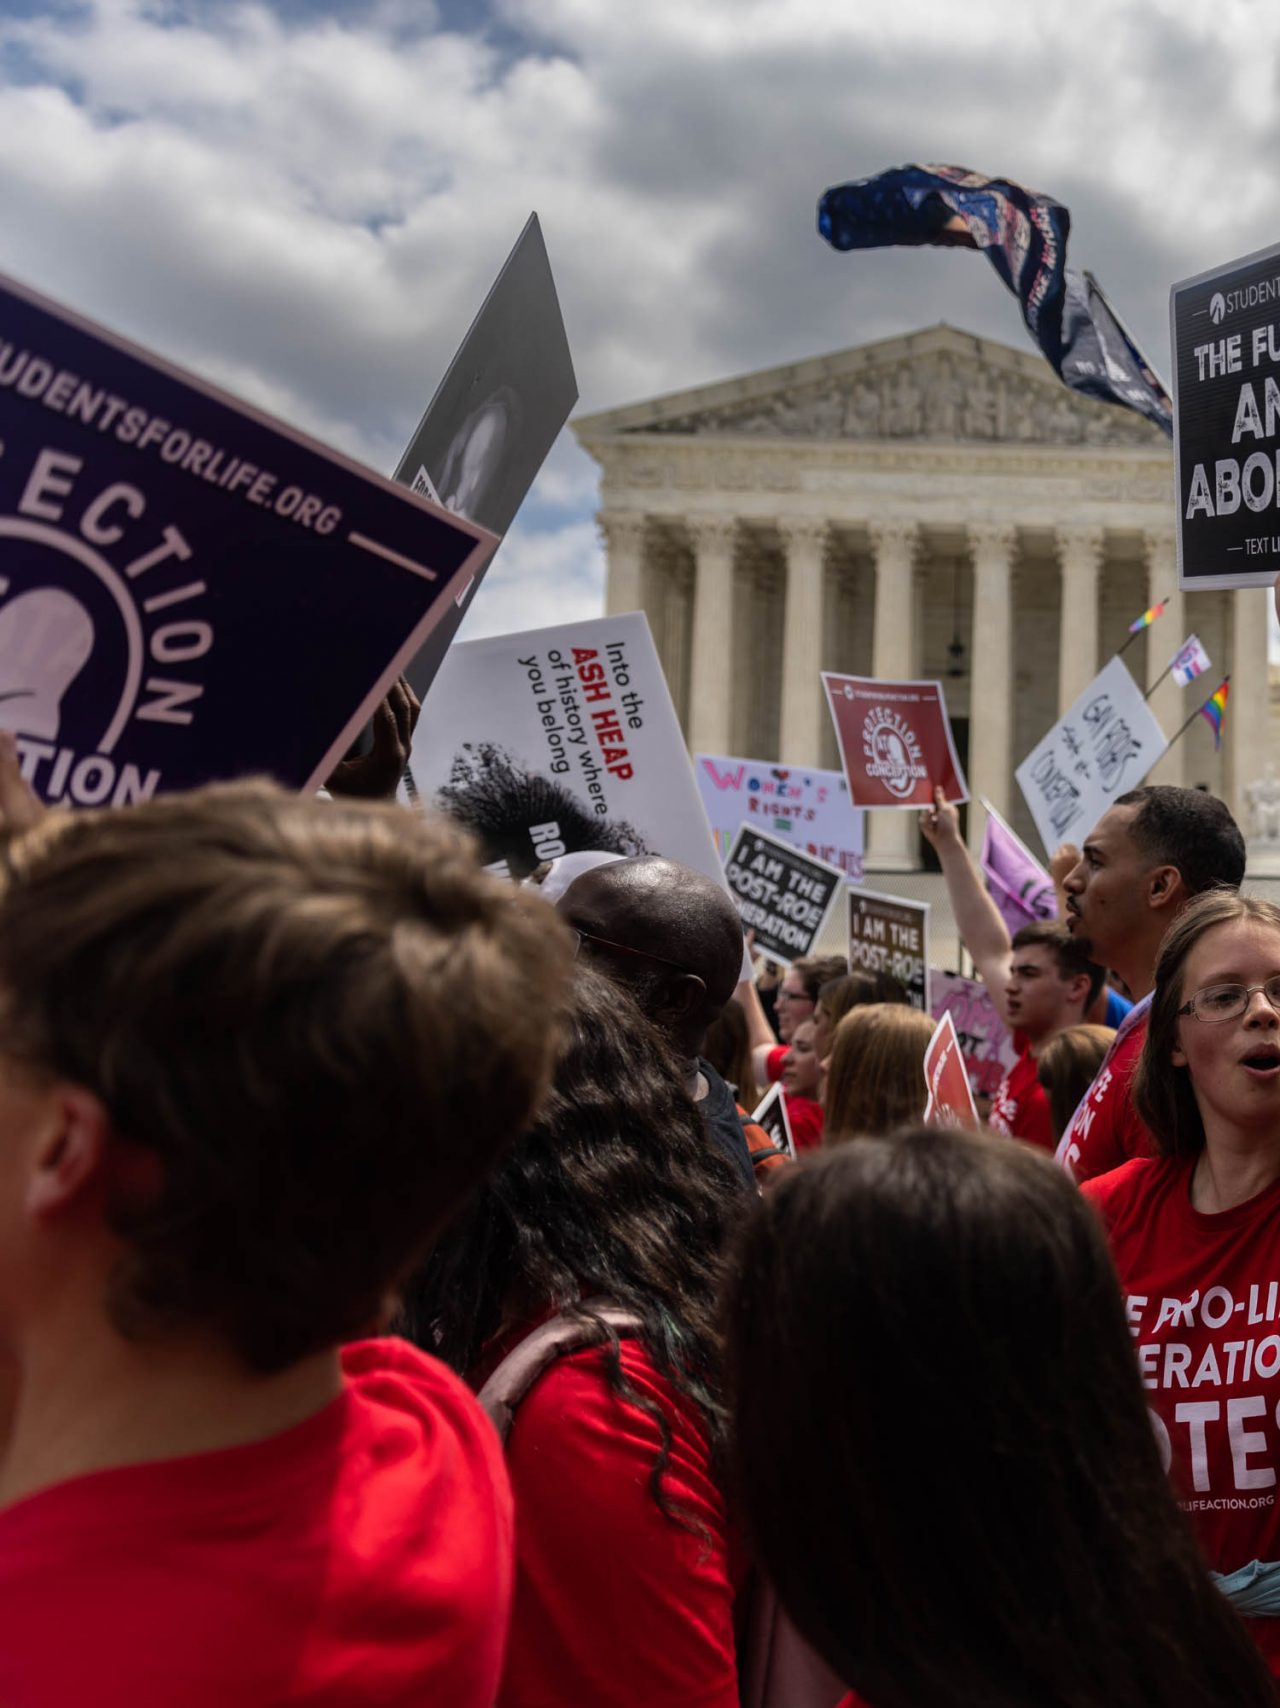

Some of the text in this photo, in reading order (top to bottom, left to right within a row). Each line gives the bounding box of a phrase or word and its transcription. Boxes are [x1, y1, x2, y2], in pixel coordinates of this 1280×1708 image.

[1194, 334, 1242, 382] THE
[1245, 537, 1269, 555] TEXT
[12, 446, 214, 726] ECTION
[605, 642, 644, 730] Into the
[517, 655, 571, 774] you belong
[548, 649, 608, 815] of history where
[571, 647, 634, 781] ASH HEAP
[862, 706, 922, 759] PROTECTION
[14, 738, 161, 807] TION
[865, 763, 928, 779] CONCEPTION
[528, 821, 566, 861] RO
[725, 862, 824, 930] POST-ROE
[737, 845, 749, 863] I
[750, 854, 784, 881] AM
[788, 869, 827, 903] THE
[738, 900, 812, 952] NERATION
[853, 913, 920, 950] I AM THE
[851, 939, 925, 986] POST-ROE
[1126, 1295, 1149, 1337] E
[1178, 1494, 1275, 1513] LIFEACTION.ORG
